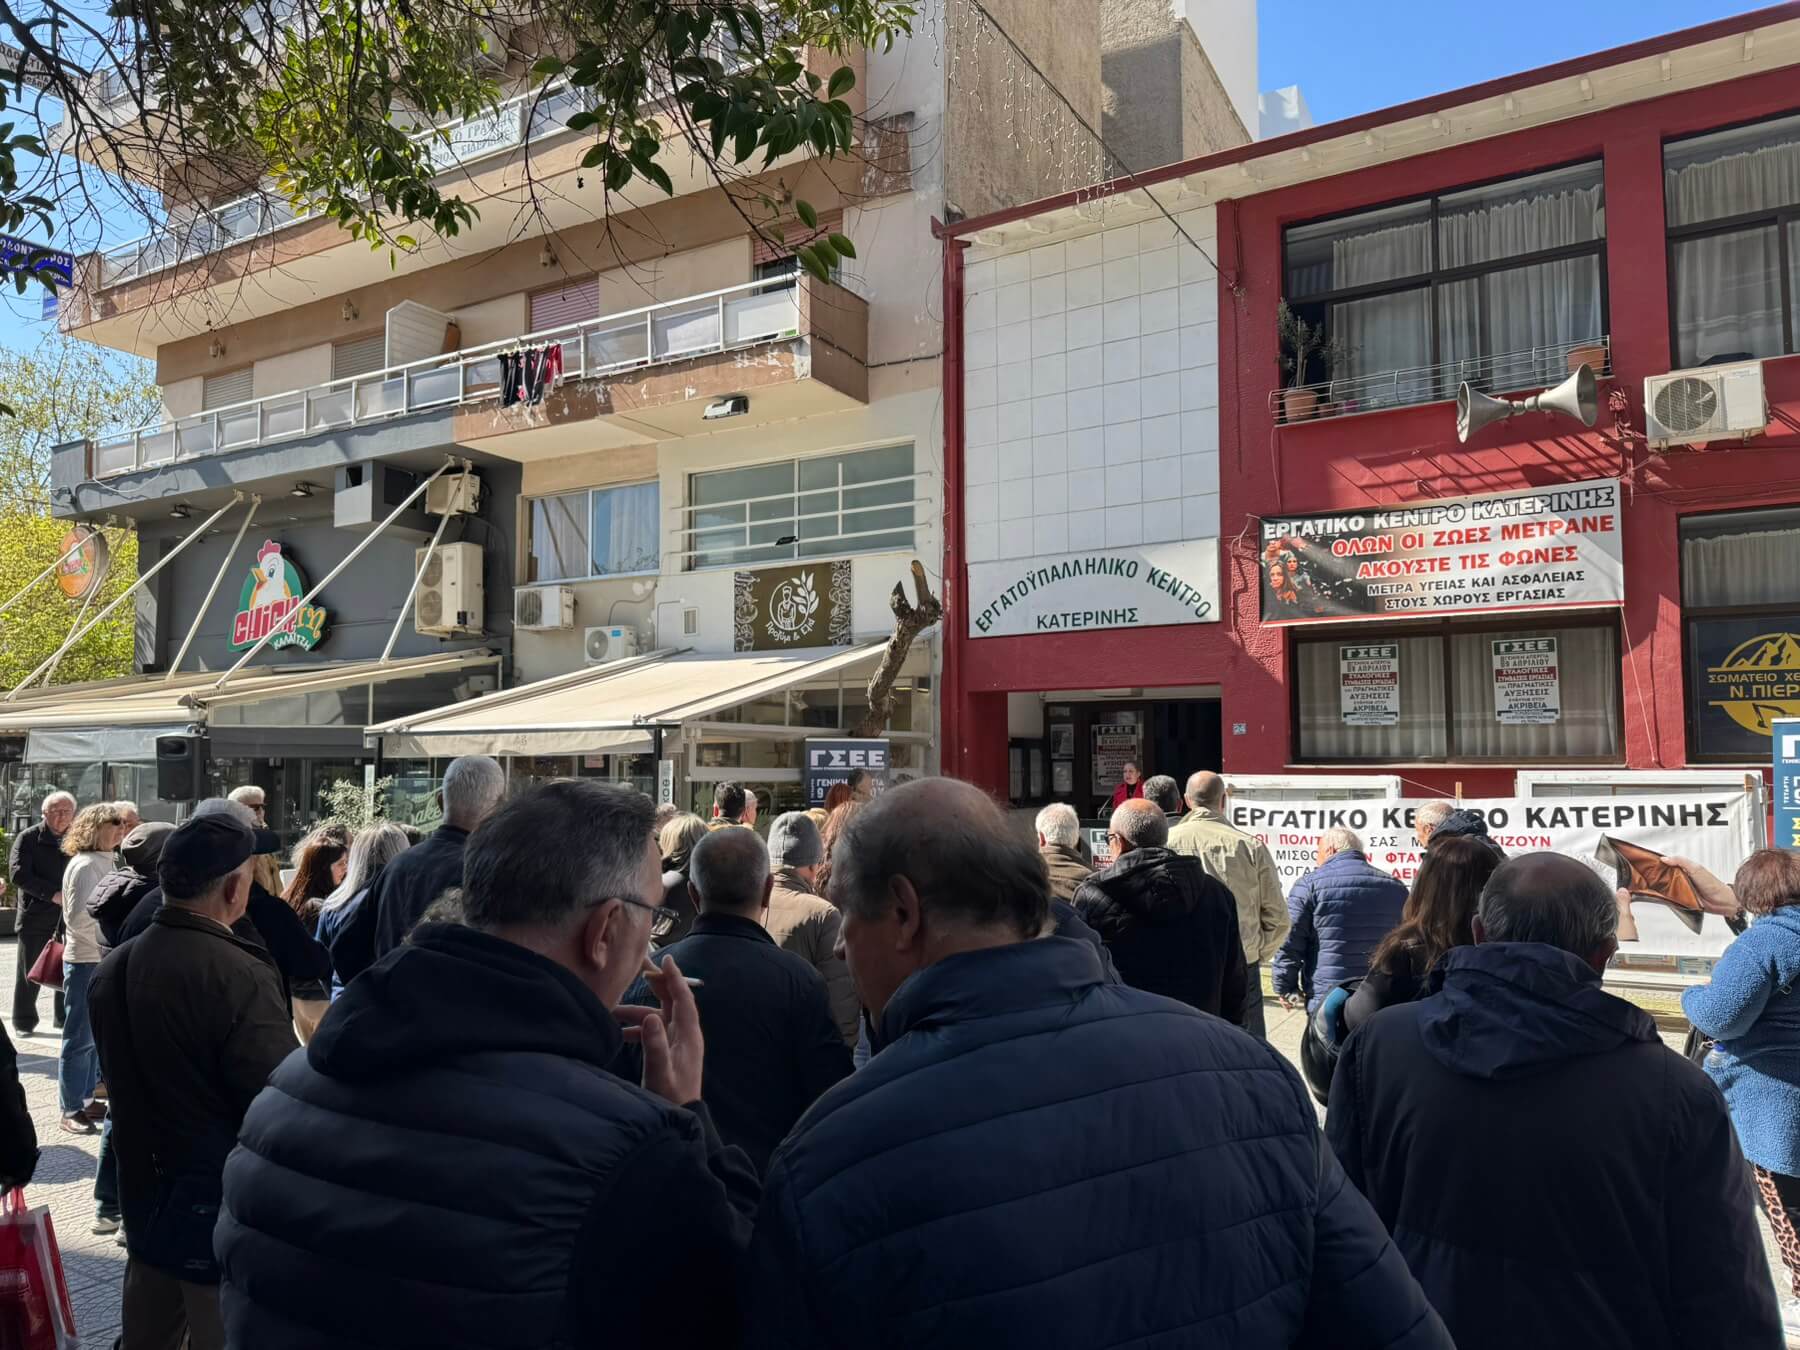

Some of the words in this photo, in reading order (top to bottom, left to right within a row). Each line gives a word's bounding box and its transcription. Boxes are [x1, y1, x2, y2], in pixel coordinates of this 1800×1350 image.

[1263, 515, 1366, 540] ΕΡΓΑΤΙΚΟ
[1373, 504, 1466, 530] ΚΕΝΤΡΟ
[1472, 486, 1614, 521] ΚΑΤΕΡΙΝΗΣ
[1332, 535, 1393, 557] ΟΛΩΝ
[1401, 532, 1425, 550] ΟΙ
[1432, 526, 1491, 547] ΖΩΕΣ
[1501, 515, 1615, 541] ΜΕΤΡΑΝΕ
[1358, 557, 1451, 578] ΑΚΟΥΣΤΕ
[1459, 553, 1490, 570] ΤΙΣ
[1499, 545, 1579, 567] ΦΩΝΕΣ
[1368, 583, 1413, 596] ΜΕΤΡΑ
[1419, 579, 1466, 592] ΥΓΕΙΑΣ
[1471, 576, 1495, 588] ΚΑΙ
[1502, 570, 1584, 586] ΑΣΦΑΛΕΙΑΣ
[975, 557, 1139, 633] ΕΡΓΑΤΟΫΠΑΛΛΗΛΙΚΟ
[1146, 566, 1212, 619] ΚΕΝΤΡΟ
[1385, 596, 1427, 609] ΣΤΟΥΣ
[1433, 592, 1490, 606] ΧΩΡΟΥΣ
[1497, 588, 1565, 602] ΕΡΓΑΣΙΑΣ
[1037, 607, 1139, 630] ΚΑΤΕΡΙΝΗΣ
[1346, 647, 1392, 658] ΓΣΕΕ
[1499, 640, 1550, 652] ΓΣΕΕ
[1708, 672, 1778, 683] ΣΩΜΑΤΕΙΟ
[1730, 685, 1749, 698] Ν.
[810, 750, 885, 766] ΓΣΕΕ
[1233, 806, 1368, 830] ΕΡΓΑΤΙΚΟ
[1525, 803, 1729, 829] ΚΑΤΕΡΙΝΗΣ
[1370, 836, 1398, 847] ΣΑΣ
